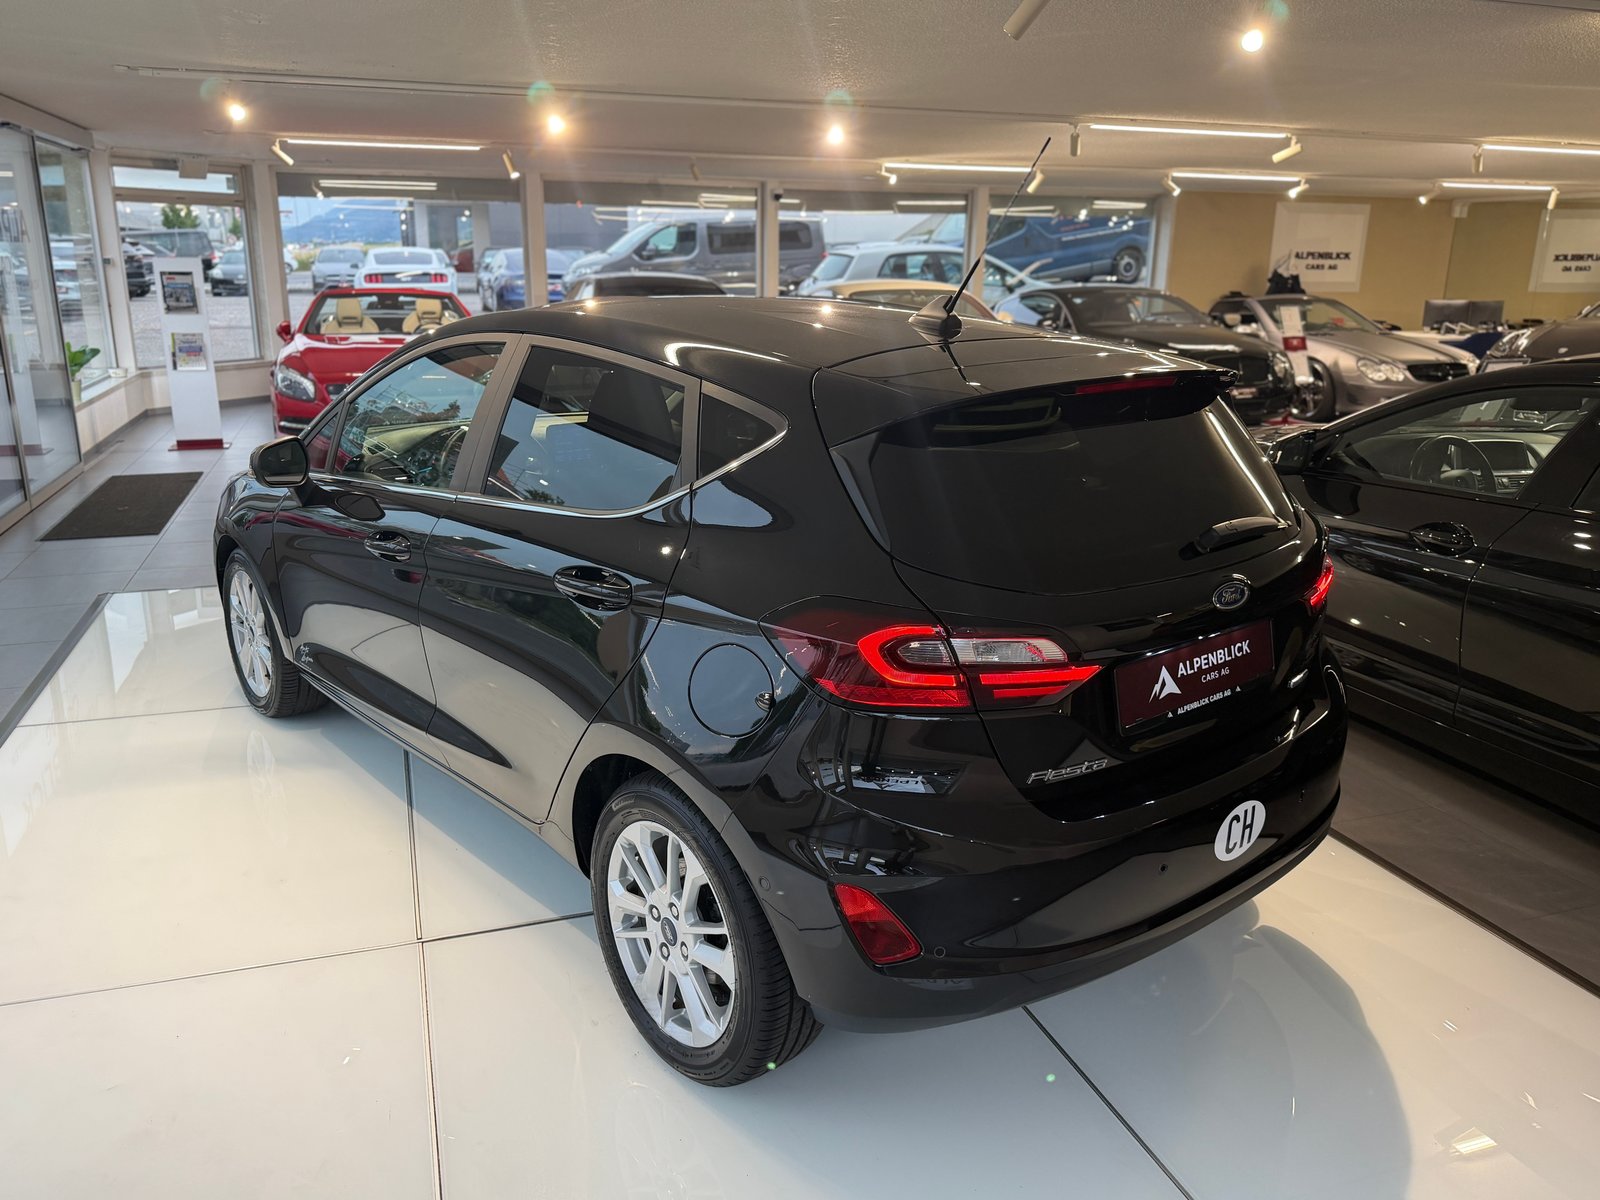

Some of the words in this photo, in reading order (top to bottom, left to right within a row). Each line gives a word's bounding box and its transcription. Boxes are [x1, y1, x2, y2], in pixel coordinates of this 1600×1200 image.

[1295, 251, 1352, 260] ALPENBLICK
[1221, 587, 1242, 605] Ford
[1177, 639, 1251, 678] ALPENBLICK
[1201, 670, 1219, 683] CARS
[1220, 666, 1230, 676] AG
[1177, 697, 1210, 715] ALPENBLICK
[1209, 690, 1224, 702] CARS
[1223, 688, 1232, 697] AG
[1026, 759, 1108, 785] Fiesta
[1225, 804, 1256, 855] CH
